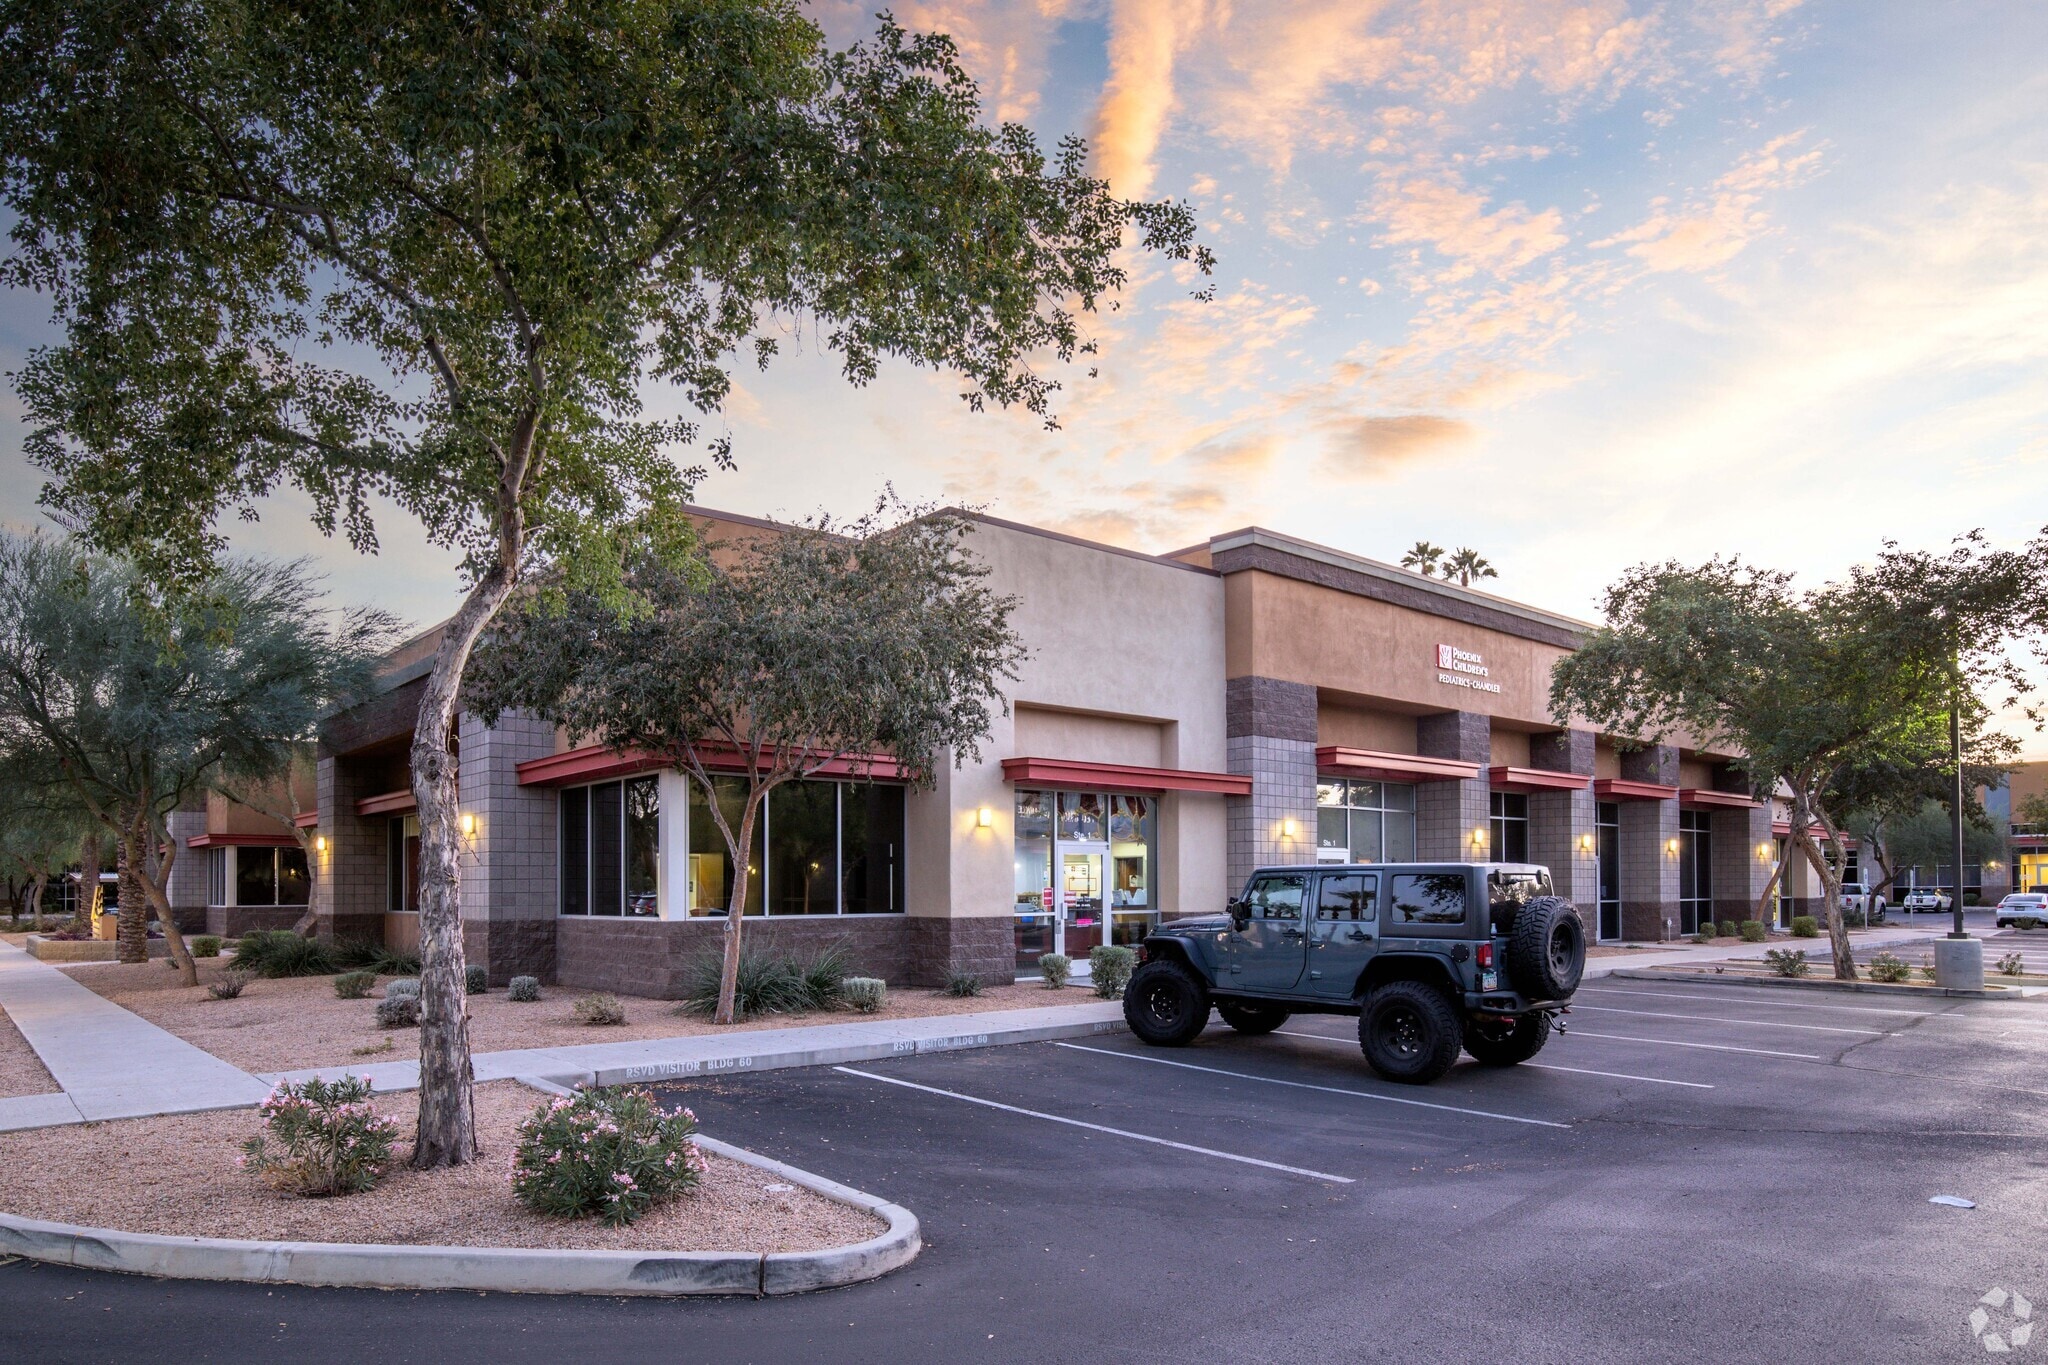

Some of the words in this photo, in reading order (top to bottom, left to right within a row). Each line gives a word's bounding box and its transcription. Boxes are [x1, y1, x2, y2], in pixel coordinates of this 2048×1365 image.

[1453, 647, 1482, 664] PHOENIX
[893, 1040, 915, 1052] RSVD
[918, 1038, 949, 1050] VISITOR
[953, 1036, 974, 1046] BLDG
[626, 1066, 655, 1079] RSVD
[659, 1061, 701, 1075] VISITOR
[707, 1058, 734, 1070] BLDG
[738, 1057, 752, 1067] 60
